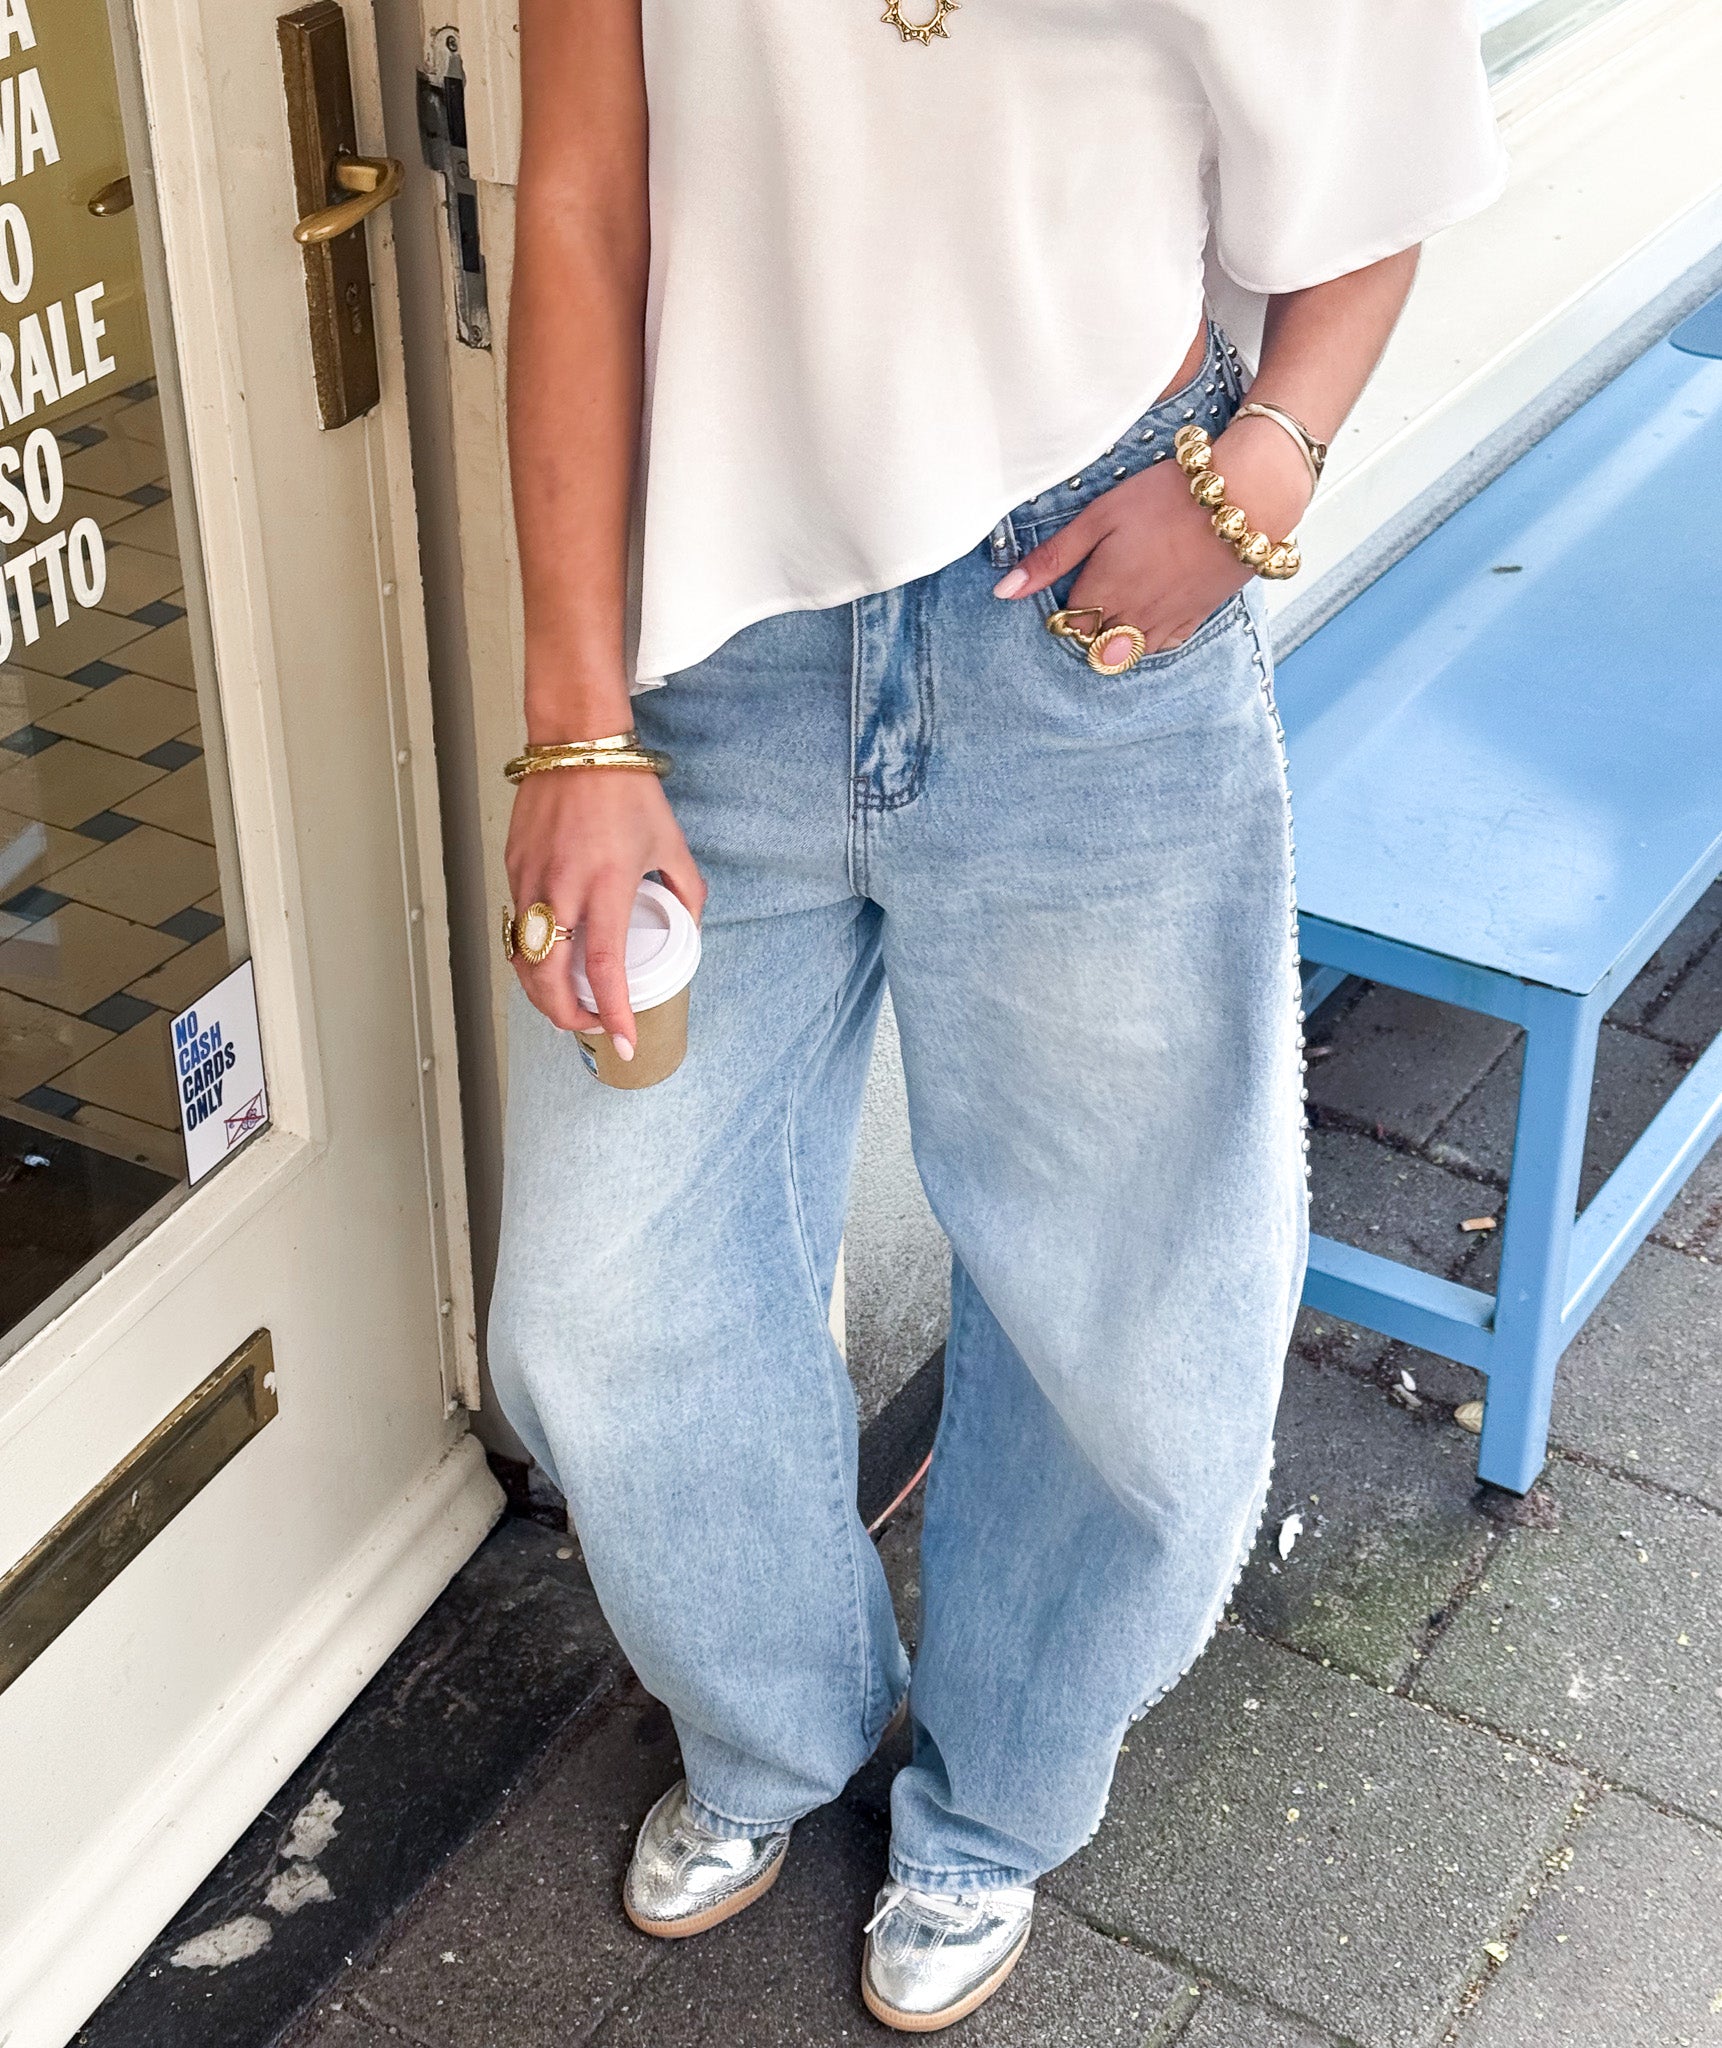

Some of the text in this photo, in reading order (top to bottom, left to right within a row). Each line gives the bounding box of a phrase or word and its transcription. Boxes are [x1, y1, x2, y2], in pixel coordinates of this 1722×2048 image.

[0, 281, 117, 430] RALE
[0, 428, 64, 544] SO
[175, 1010, 199, 1049] NO
[179, 1021, 222, 1077] CASH
[183, 1042, 235, 1104] CARDS
[186, 1079, 223, 1132] ONLY
